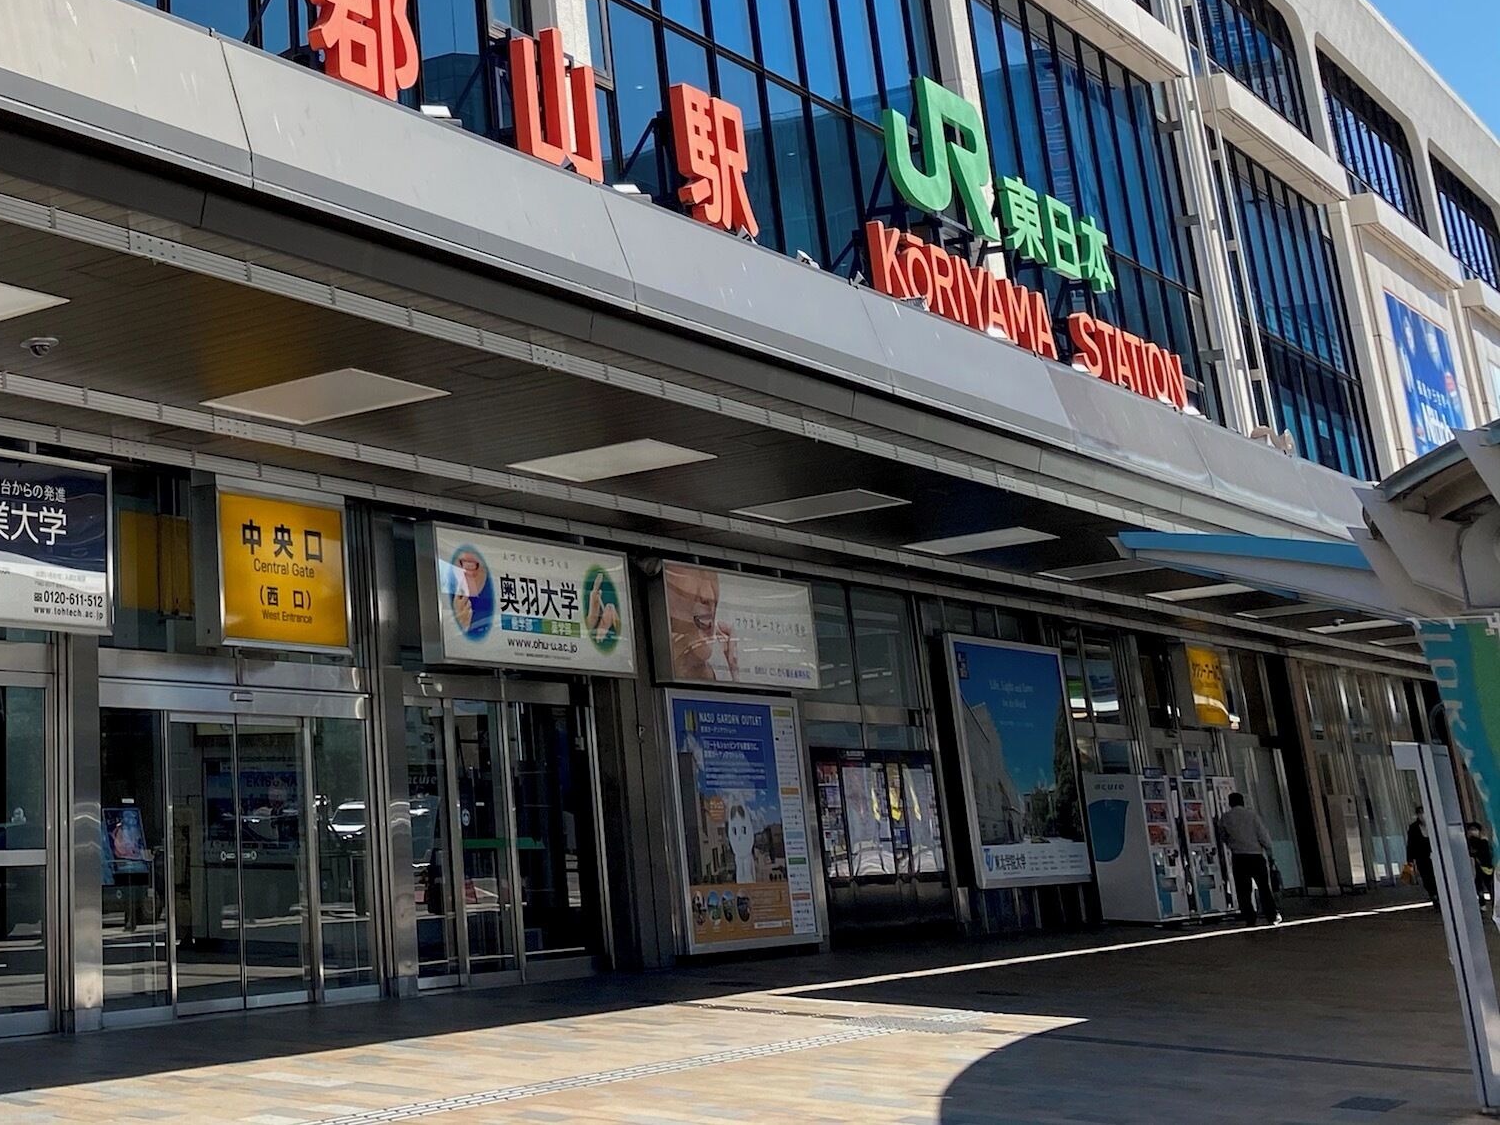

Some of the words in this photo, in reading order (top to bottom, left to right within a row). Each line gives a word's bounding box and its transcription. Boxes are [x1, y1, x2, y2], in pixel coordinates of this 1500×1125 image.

[883, 75, 1001, 242] JR
[1001, 175, 1116, 293] 東日本
[1069, 312, 1188, 411] STATION
[242, 519, 323, 563] 中央口
[253, 558, 289, 575] Central
[292, 563, 315, 578] Gate
[43, 590, 103, 608] 0120-611-512
[500, 573, 579, 620] 奥羽大学
[262, 609, 280, 620] West
[282, 611, 313, 624] Entrance
[1094, 782, 1125, 792] acure
